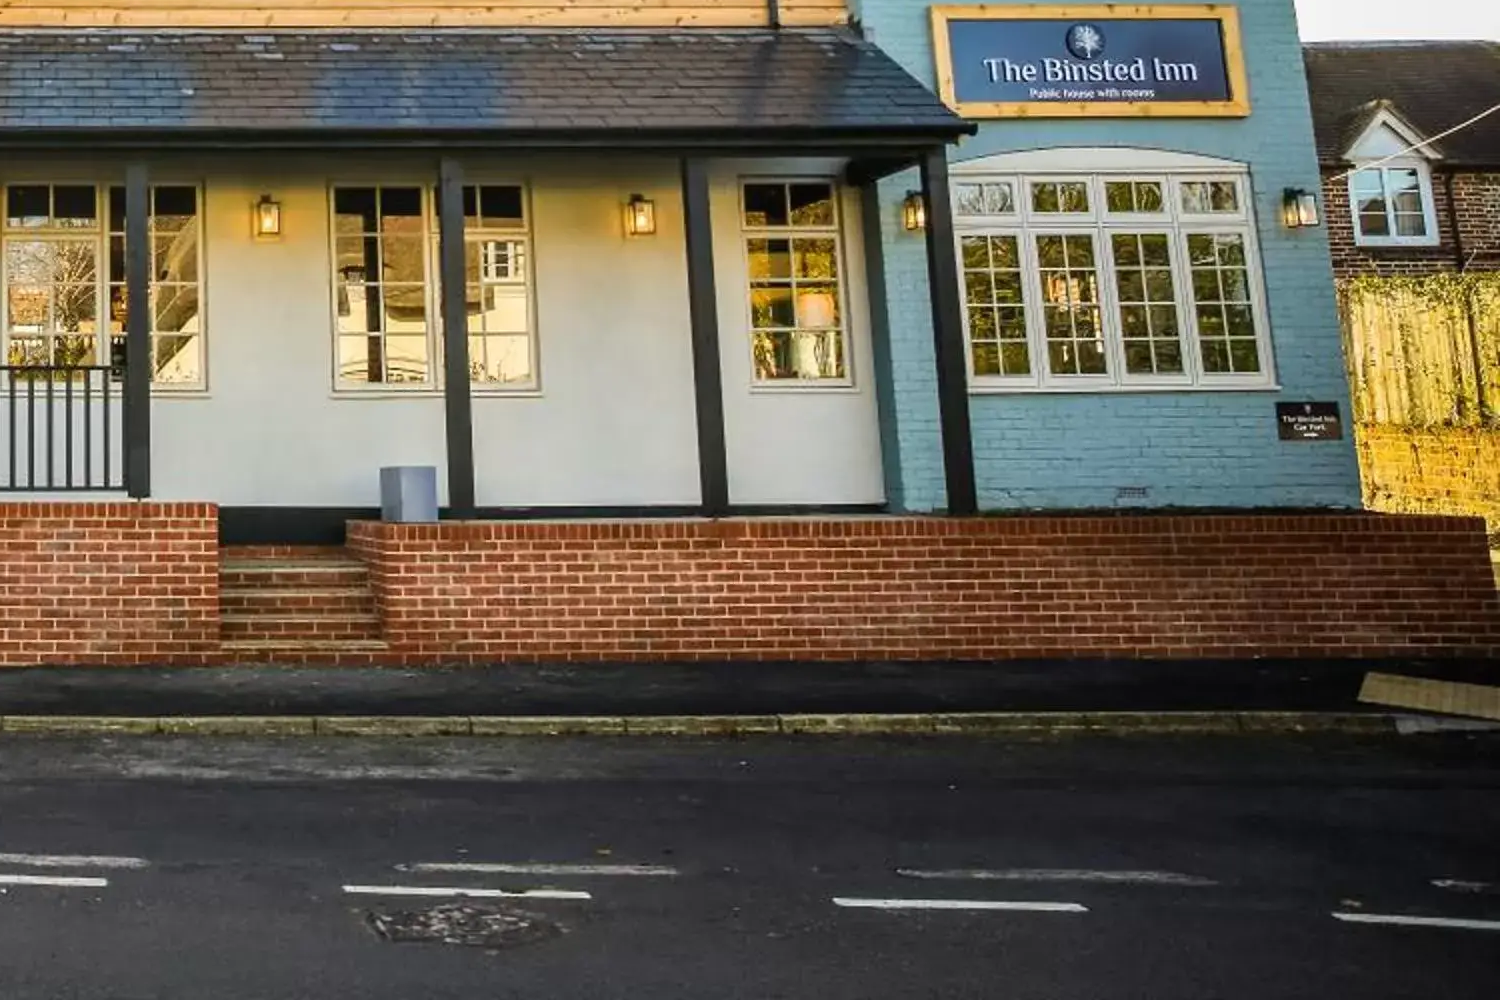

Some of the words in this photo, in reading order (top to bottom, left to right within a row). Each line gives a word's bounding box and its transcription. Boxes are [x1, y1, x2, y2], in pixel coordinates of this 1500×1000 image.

[983, 57, 1037, 81] The
[1044, 57, 1145, 81] Binsted
[1153, 57, 1198, 81] Inn
[1029, 87, 1061, 99] Public
[1063, 88, 1095, 99] house
[1097, 87, 1121, 98] with
[1121, 87, 1155, 98] rooms
